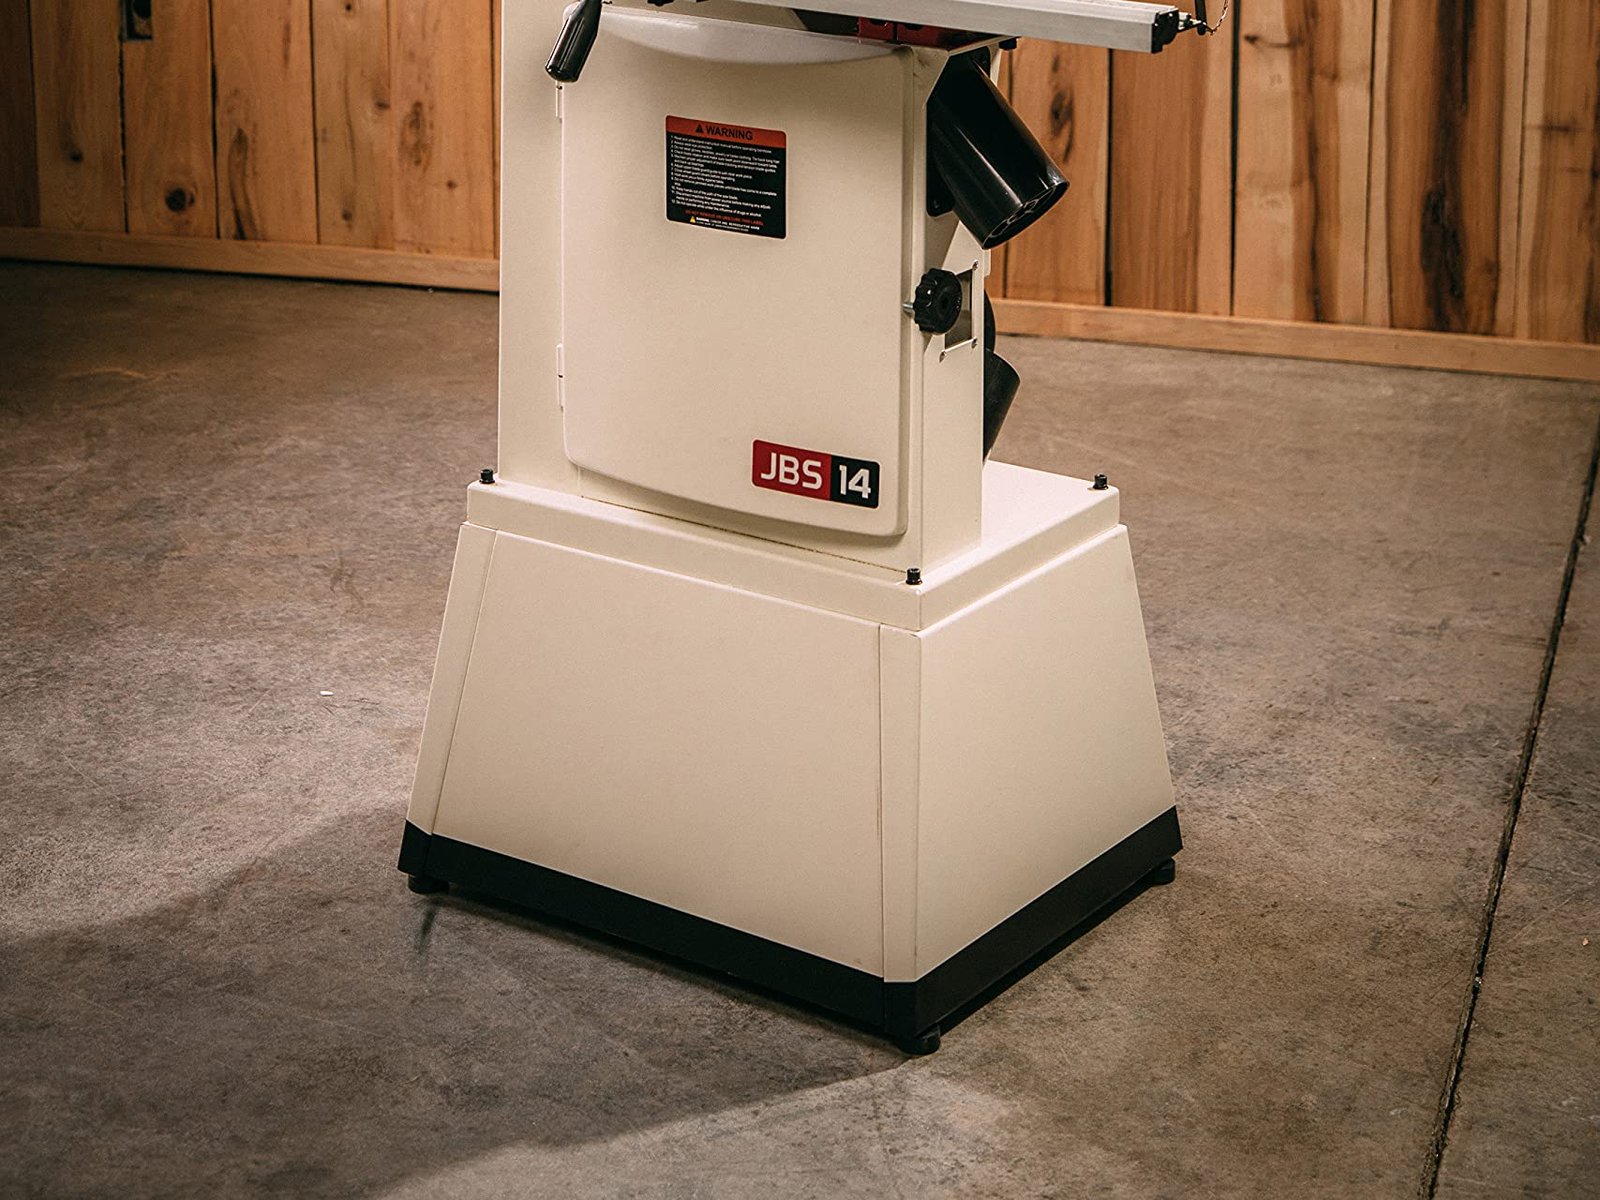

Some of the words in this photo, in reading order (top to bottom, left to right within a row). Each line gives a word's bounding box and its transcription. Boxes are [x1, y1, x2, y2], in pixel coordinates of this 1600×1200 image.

[705, 125, 754, 141] WARNING
[760, 452, 823, 490] JBS
[839, 464, 872, 499] 14
